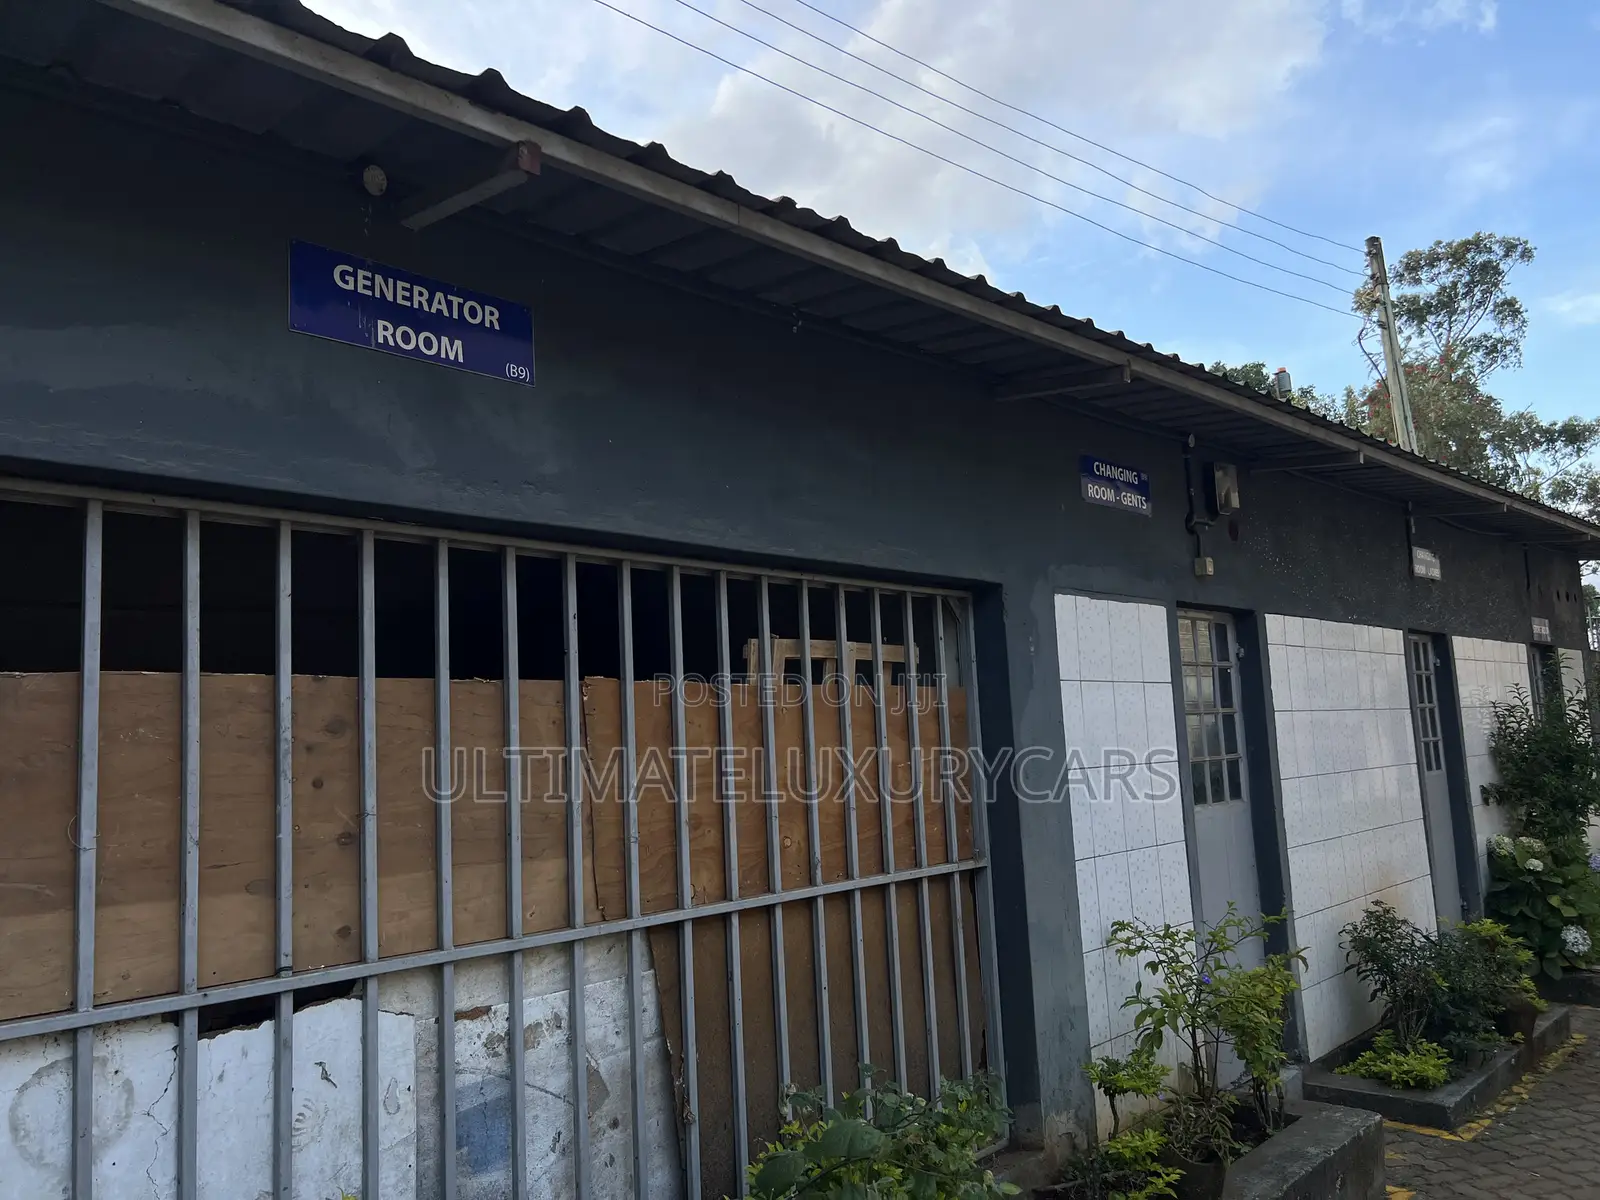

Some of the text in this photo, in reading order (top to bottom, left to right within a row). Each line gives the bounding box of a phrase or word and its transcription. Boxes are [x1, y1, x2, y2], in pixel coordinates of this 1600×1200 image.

[333, 264, 501, 331] GENERATOR
[376, 319, 464, 363] ROOM
[505, 362, 531, 382] (B9)
[1093, 461, 1139, 485] CHANGING
[1087, 483, 1116, 503] ROOM
[1121, 491, 1148, 510] GENTS
